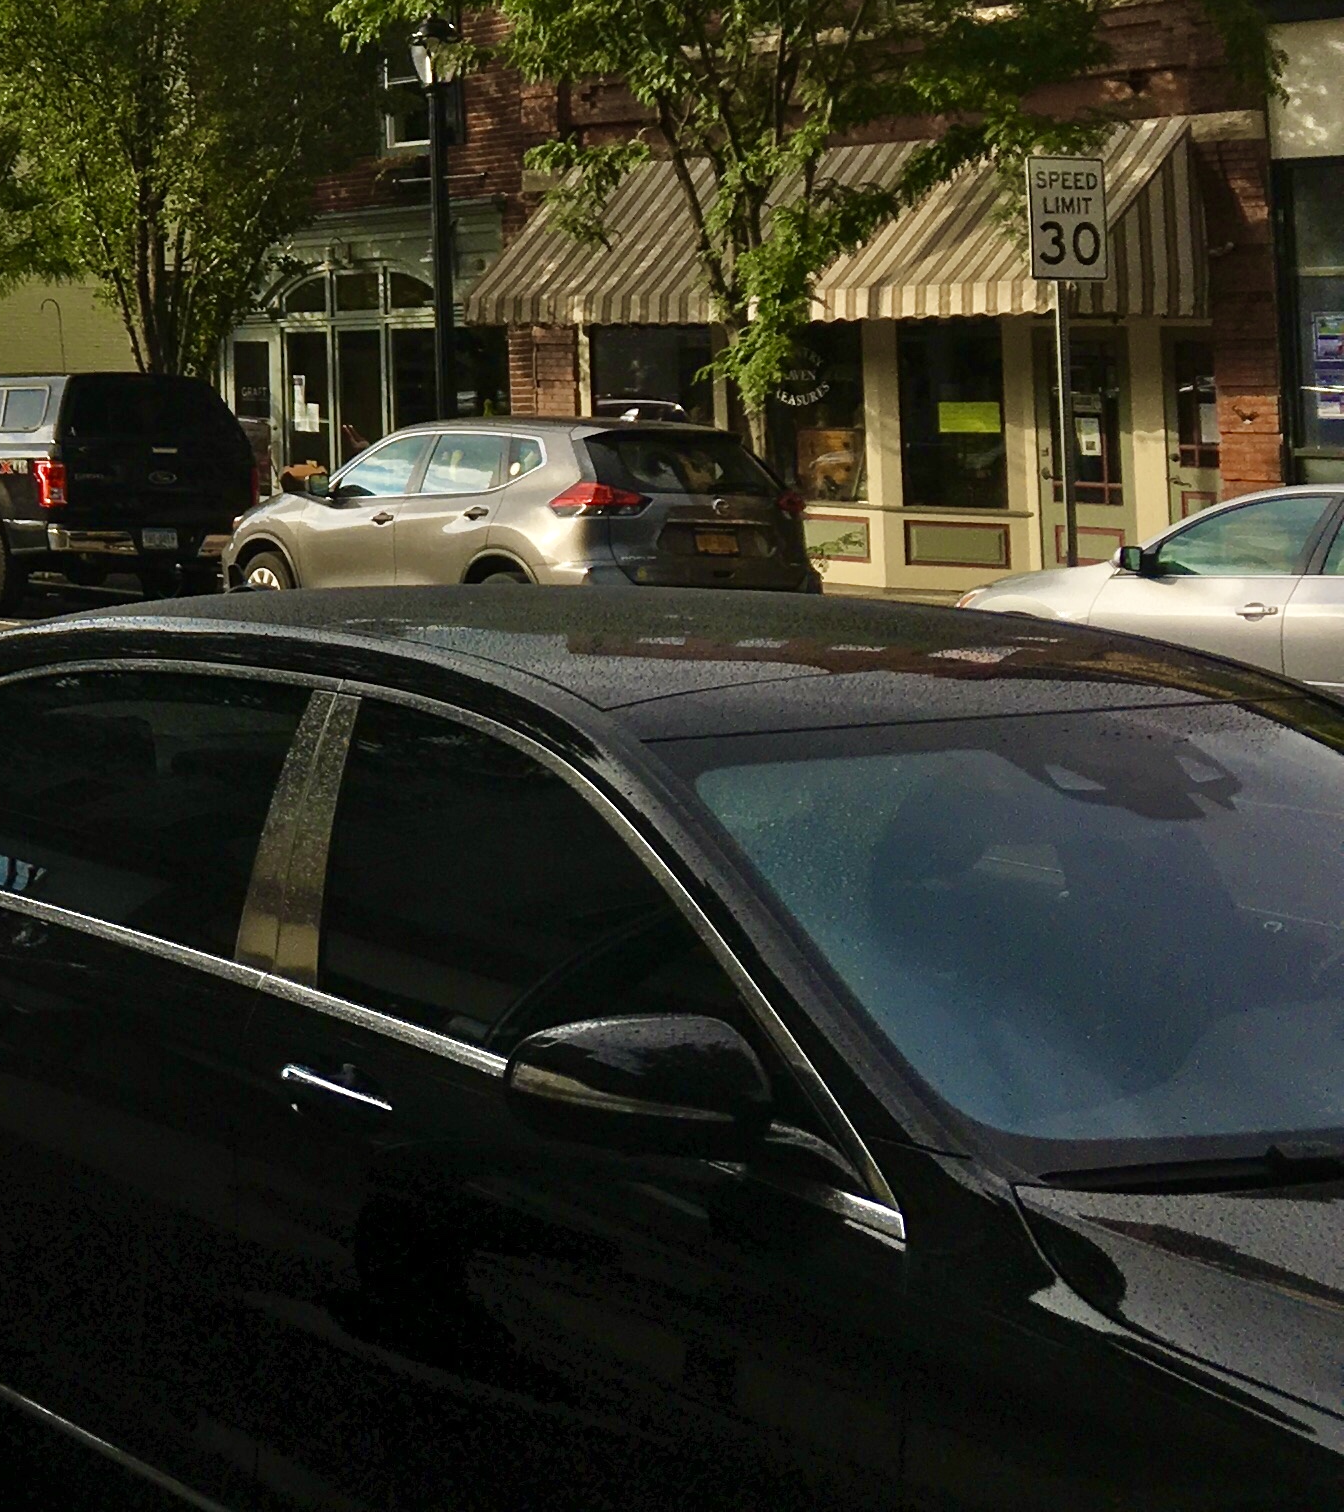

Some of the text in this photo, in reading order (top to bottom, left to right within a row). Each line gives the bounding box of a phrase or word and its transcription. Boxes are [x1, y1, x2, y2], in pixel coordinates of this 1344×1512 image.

[1035, 171, 1098, 190] SPEED
[1043, 196, 1093, 215] LIMIT
[1039, 220, 1101, 266] 30
[776, 380, 830, 406] EASURES
